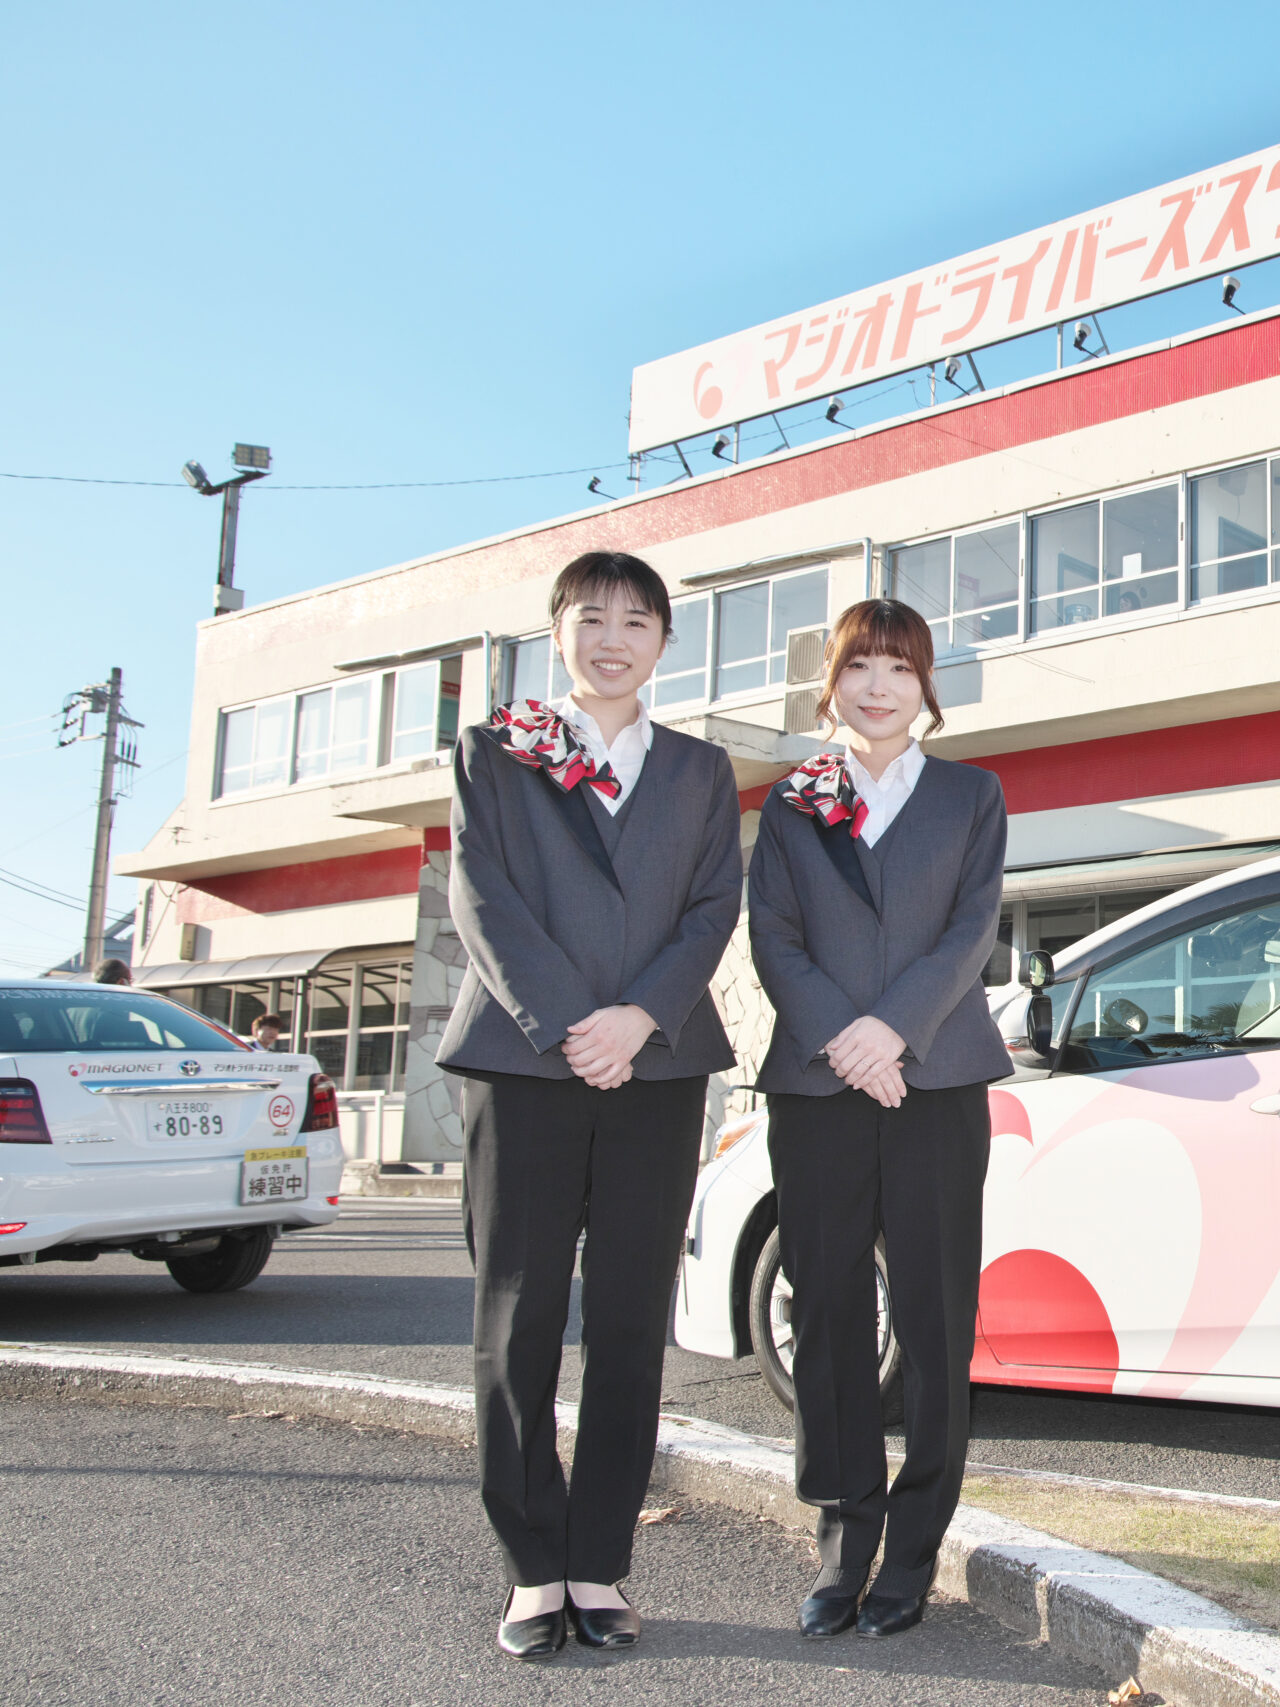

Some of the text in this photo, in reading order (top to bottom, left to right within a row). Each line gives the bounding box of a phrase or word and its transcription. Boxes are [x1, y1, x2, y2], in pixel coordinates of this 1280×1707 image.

[272, 1105, 291, 1119] 64
[166, 1115, 223, 1137] 80-89
[248, 1174, 302, 1198] 練習中
